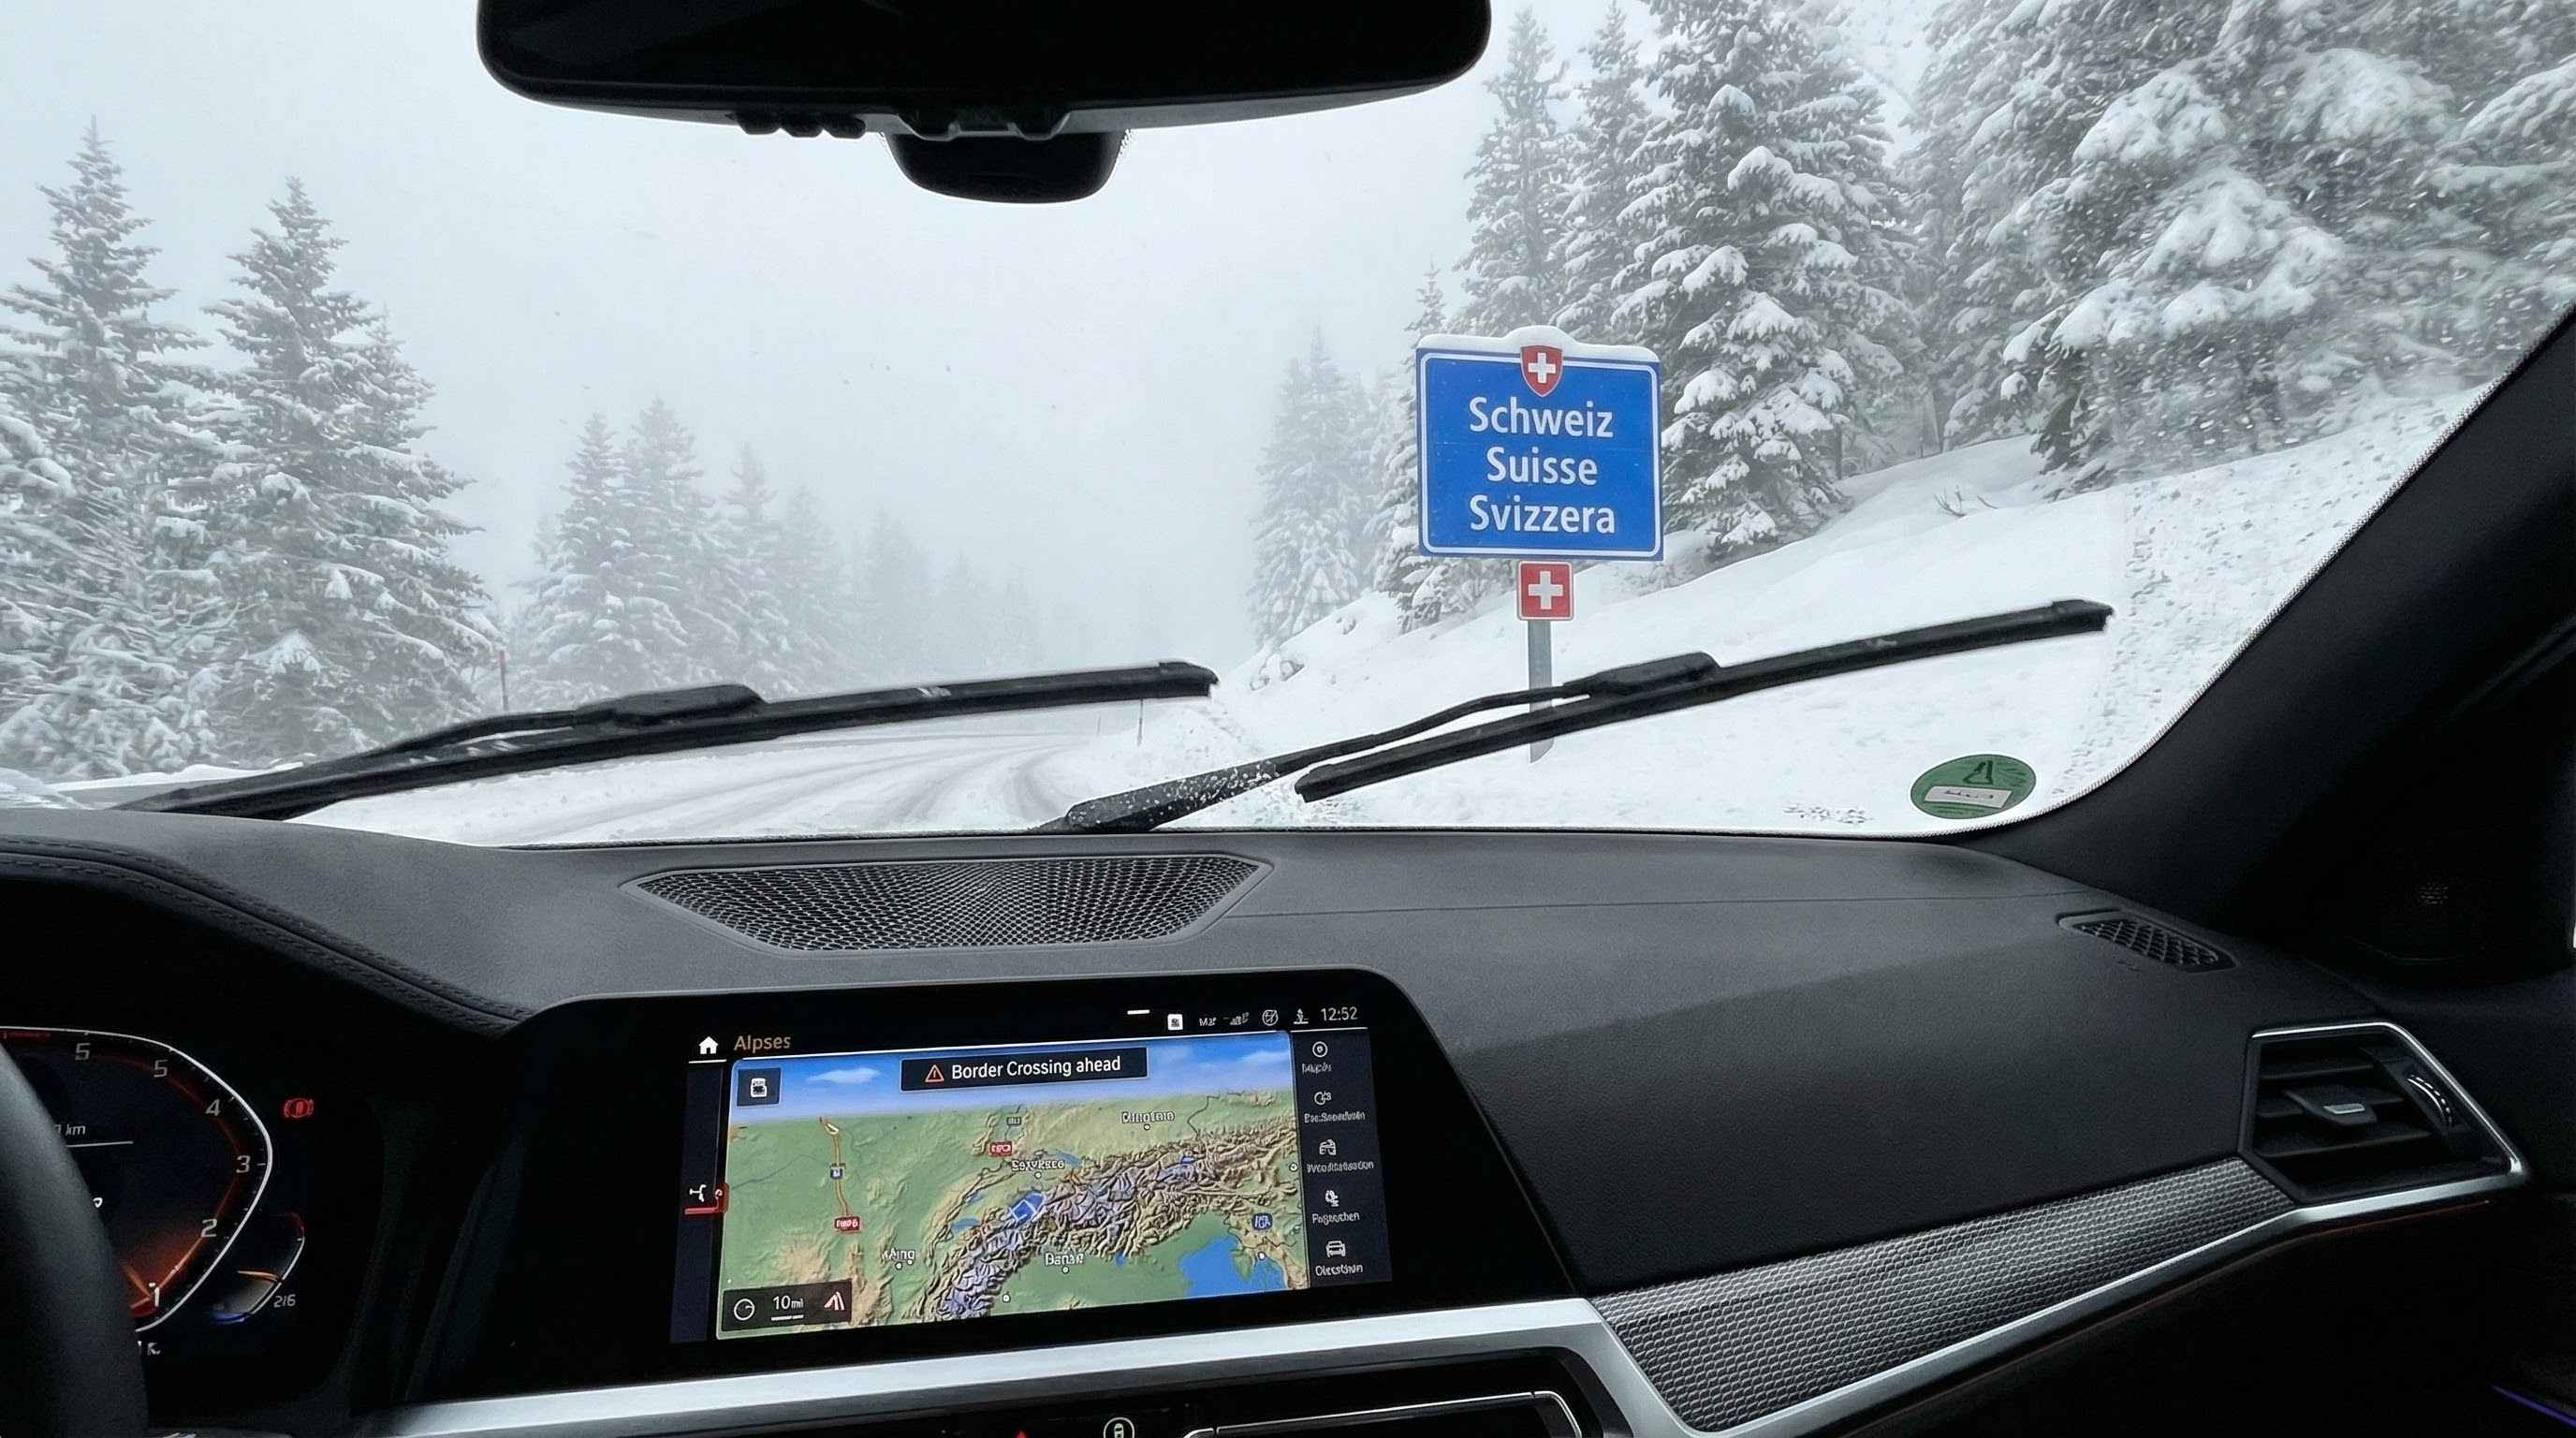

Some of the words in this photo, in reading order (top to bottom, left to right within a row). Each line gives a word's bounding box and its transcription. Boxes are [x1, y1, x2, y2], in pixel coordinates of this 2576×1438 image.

[1469, 396, 1615, 438] Schweiz
[1486, 446, 1598, 486] Suisse
[1469, 493, 1617, 535] Svizzera
[1320, 1006, 1358, 1022] 12:52
[75, 1042, 91, 1061] 5
[734, 1034, 792, 1054] Alpses
[153, 1059, 168, 1078] 5
[951, 1063, 1003, 1079] Border
[1006, 1059, 1072, 1078] Crossing
[1076, 1055, 1121, 1073] ahead
[205, 1099, 222, 1116] 4
[235, 1155, 251, 1175] 3
[200, 1218, 218, 1239] 2
